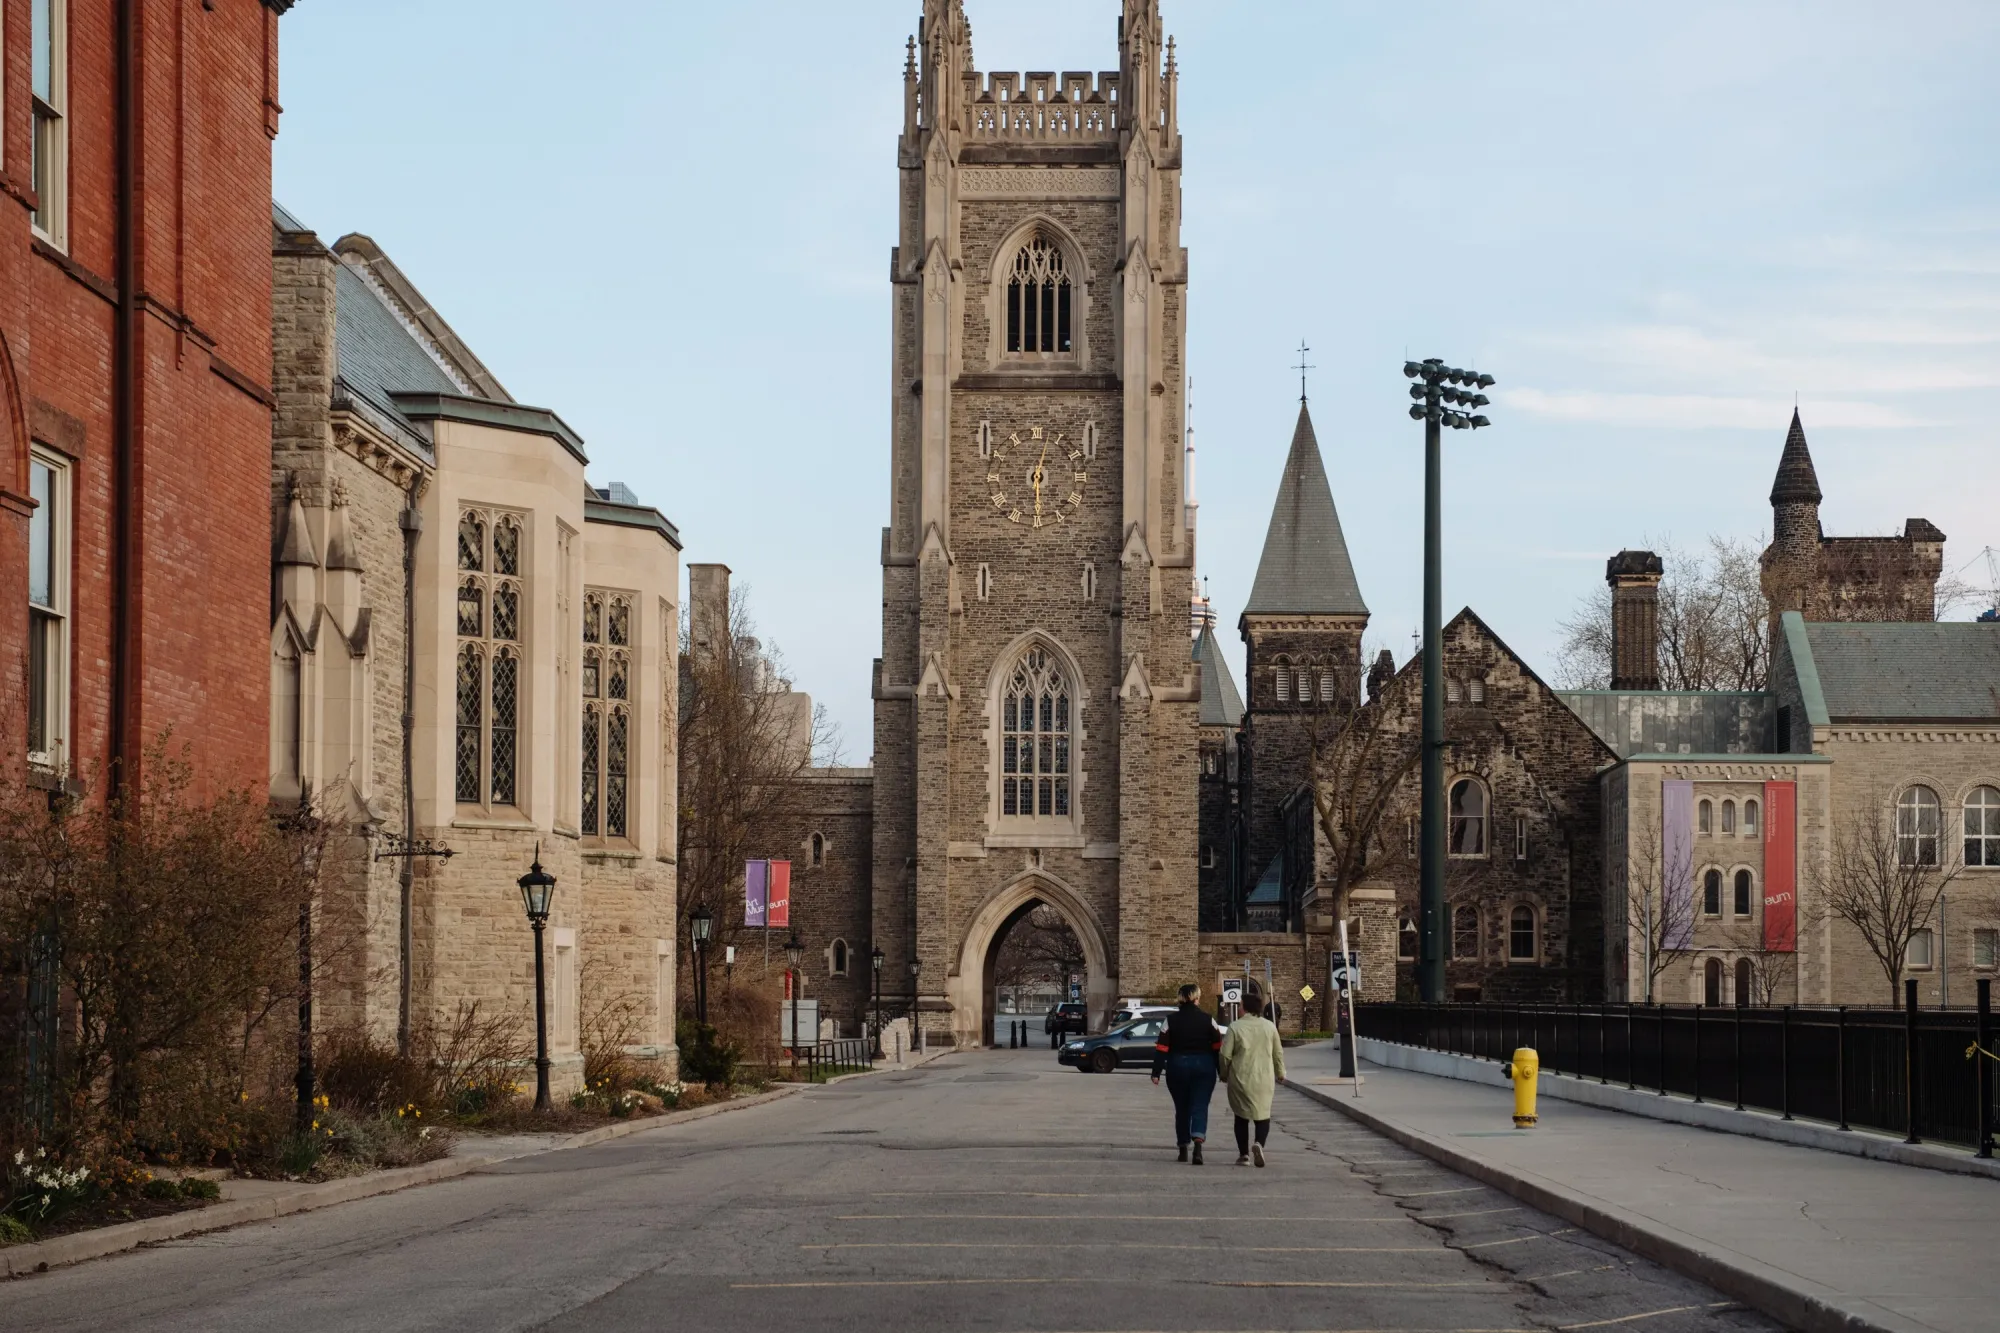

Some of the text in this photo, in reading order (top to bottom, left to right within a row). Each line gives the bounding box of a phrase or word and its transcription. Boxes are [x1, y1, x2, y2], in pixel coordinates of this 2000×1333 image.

[1031, 426, 1043, 440] XII
[1009, 432, 1021, 446] XI
[1055, 434, 1064, 445] I
[994, 450, 1006, 462] X
[1068, 450, 1082, 460] II
[1074, 472, 1087, 482] III
[1055, 510, 1065, 522] V
[747, 898, 758, 907] Art
[770, 899, 788, 909] eum
[1764, 892, 1791, 905] eum
